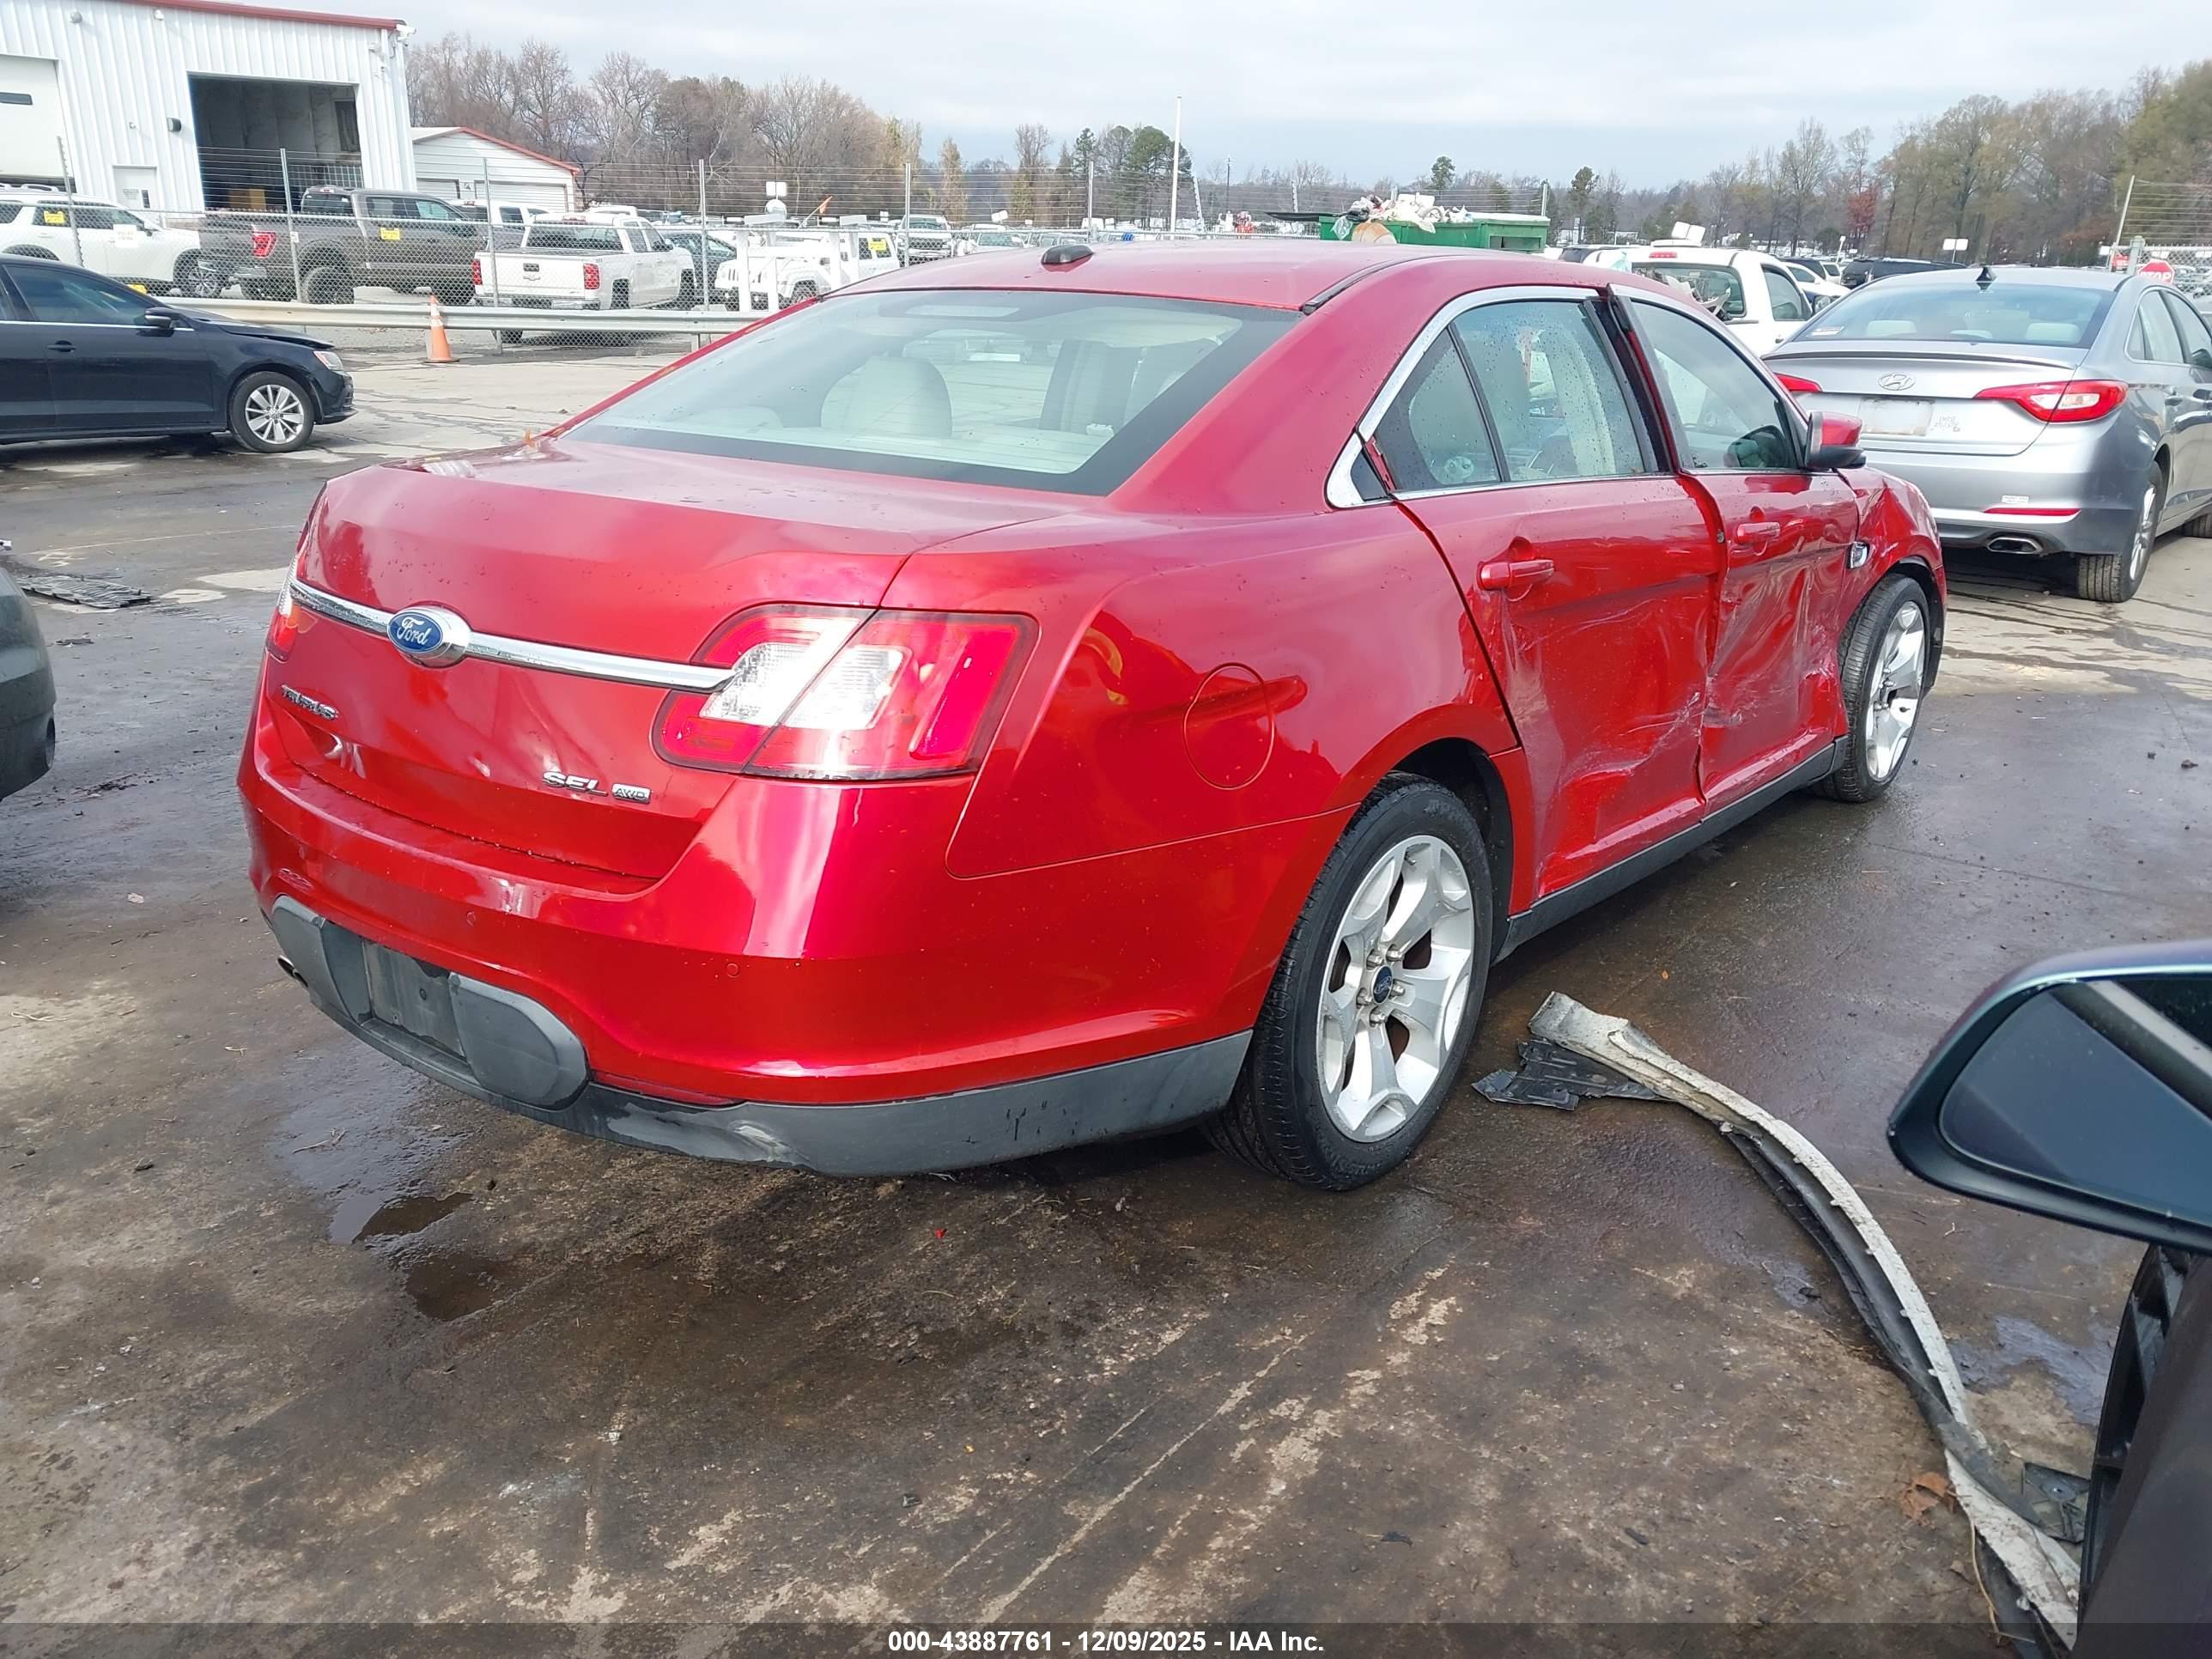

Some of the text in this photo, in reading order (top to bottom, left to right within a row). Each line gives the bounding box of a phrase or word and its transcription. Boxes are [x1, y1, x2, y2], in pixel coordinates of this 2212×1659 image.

[396, 617, 432, 645] Ford
[542, 770, 648, 801] SEL AWD
